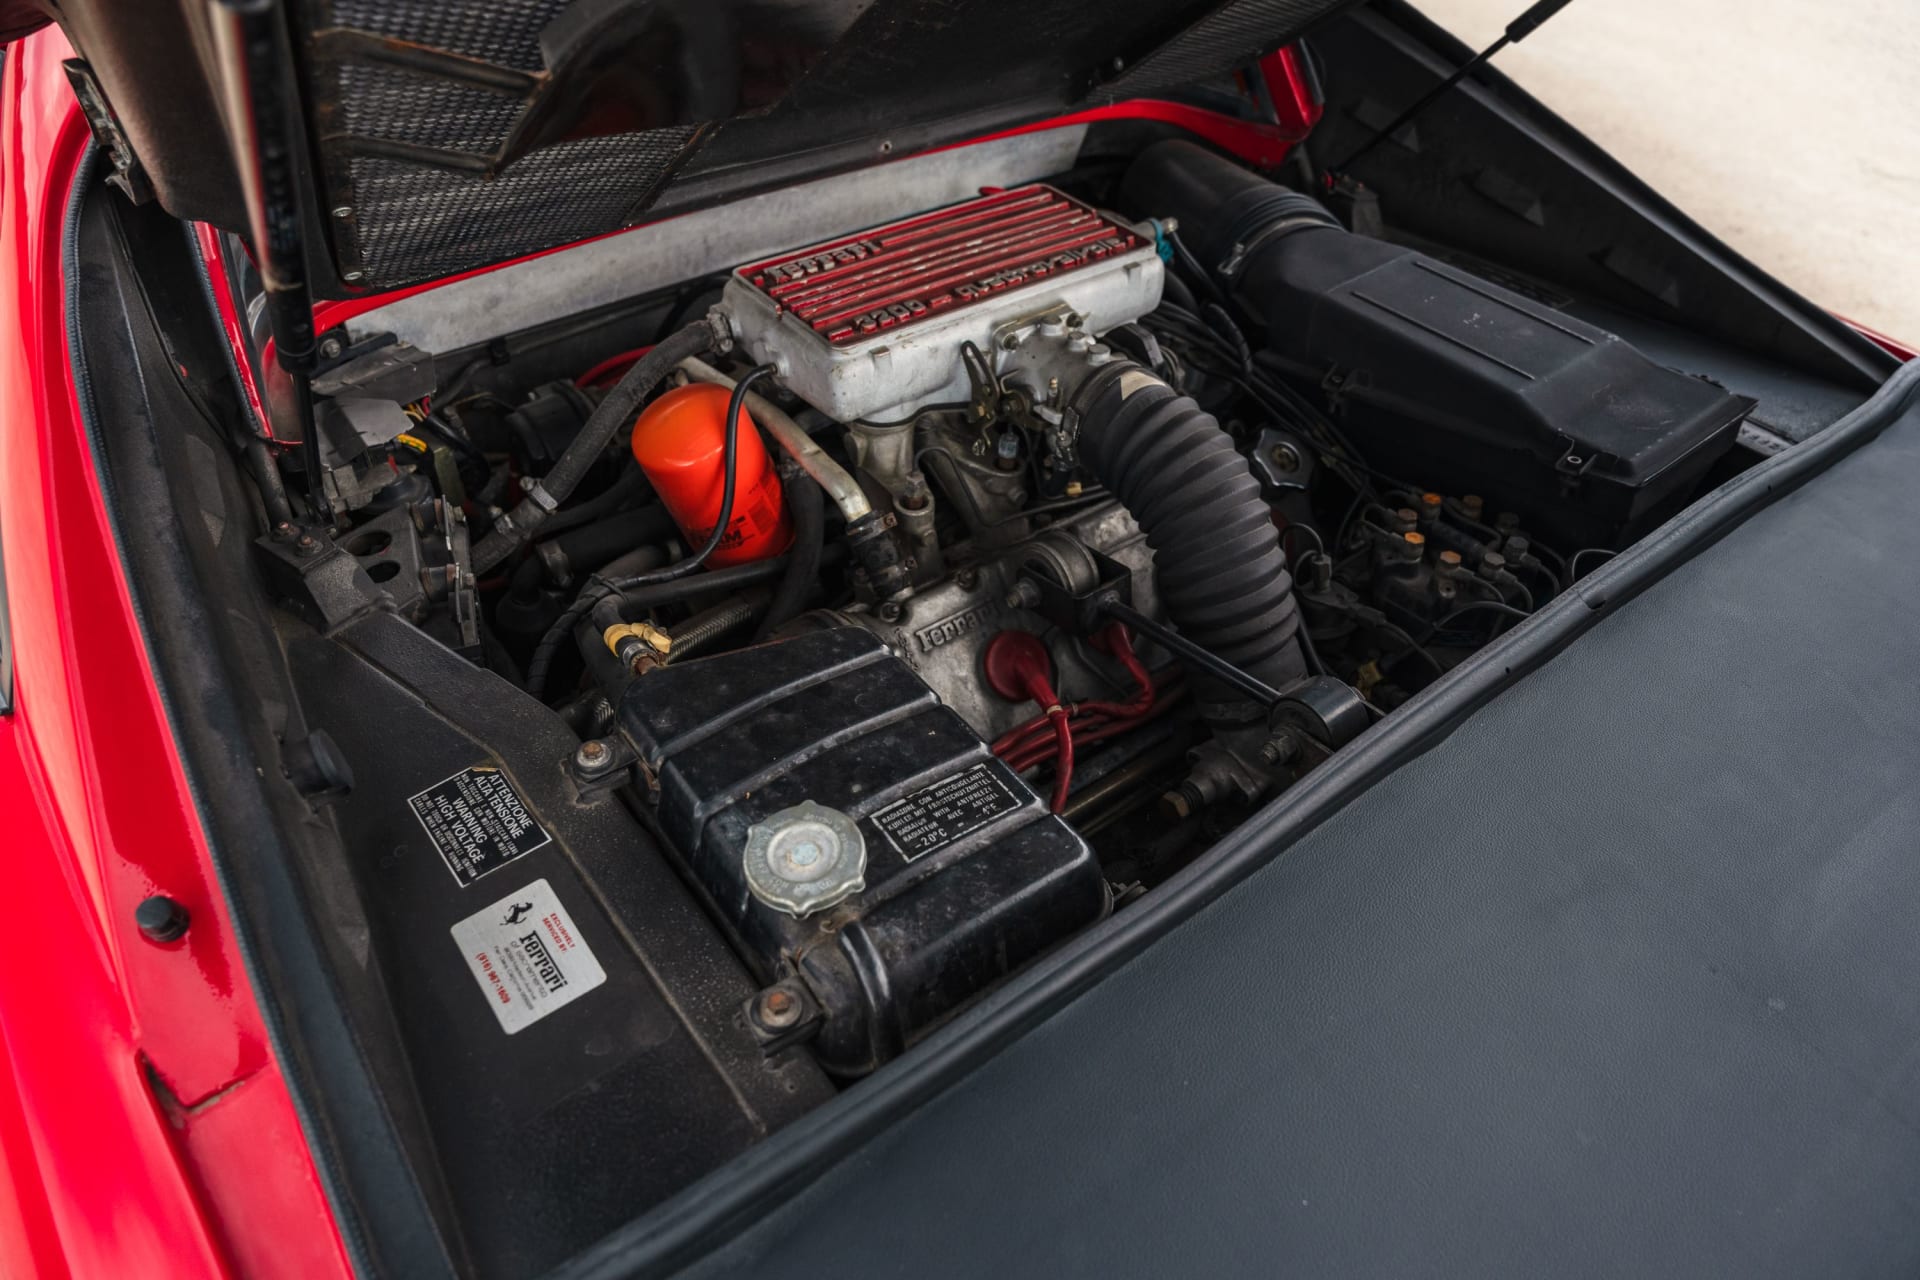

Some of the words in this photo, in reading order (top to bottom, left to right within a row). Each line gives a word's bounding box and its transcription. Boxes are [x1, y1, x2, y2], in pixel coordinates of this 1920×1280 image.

[763, 240, 882, 283] Ferrari
[853, 299, 927, 335] 3200
[914, 600, 998, 653] Ferrari
[452, 797, 488, 843] WARNING
[473, 775, 494, 797] ALTA
[488, 793, 524, 839] TENSIONE
[488, 774, 533, 829] ATTENZIONE
[918, 795, 933, 805] CON
[932, 806, 951, 818] WITH
[434, 794, 457, 821] HIGH
[451, 820, 485, 864] VOLTAGE
[902, 821, 939, 842] RADIATEUR
[947, 809, 964, 820] AVEC
[542, 917, 562, 944] SERVICED
[550, 912, 575, 948] EXCLUSIVELY
[519, 930, 567, 992] Ferrari
